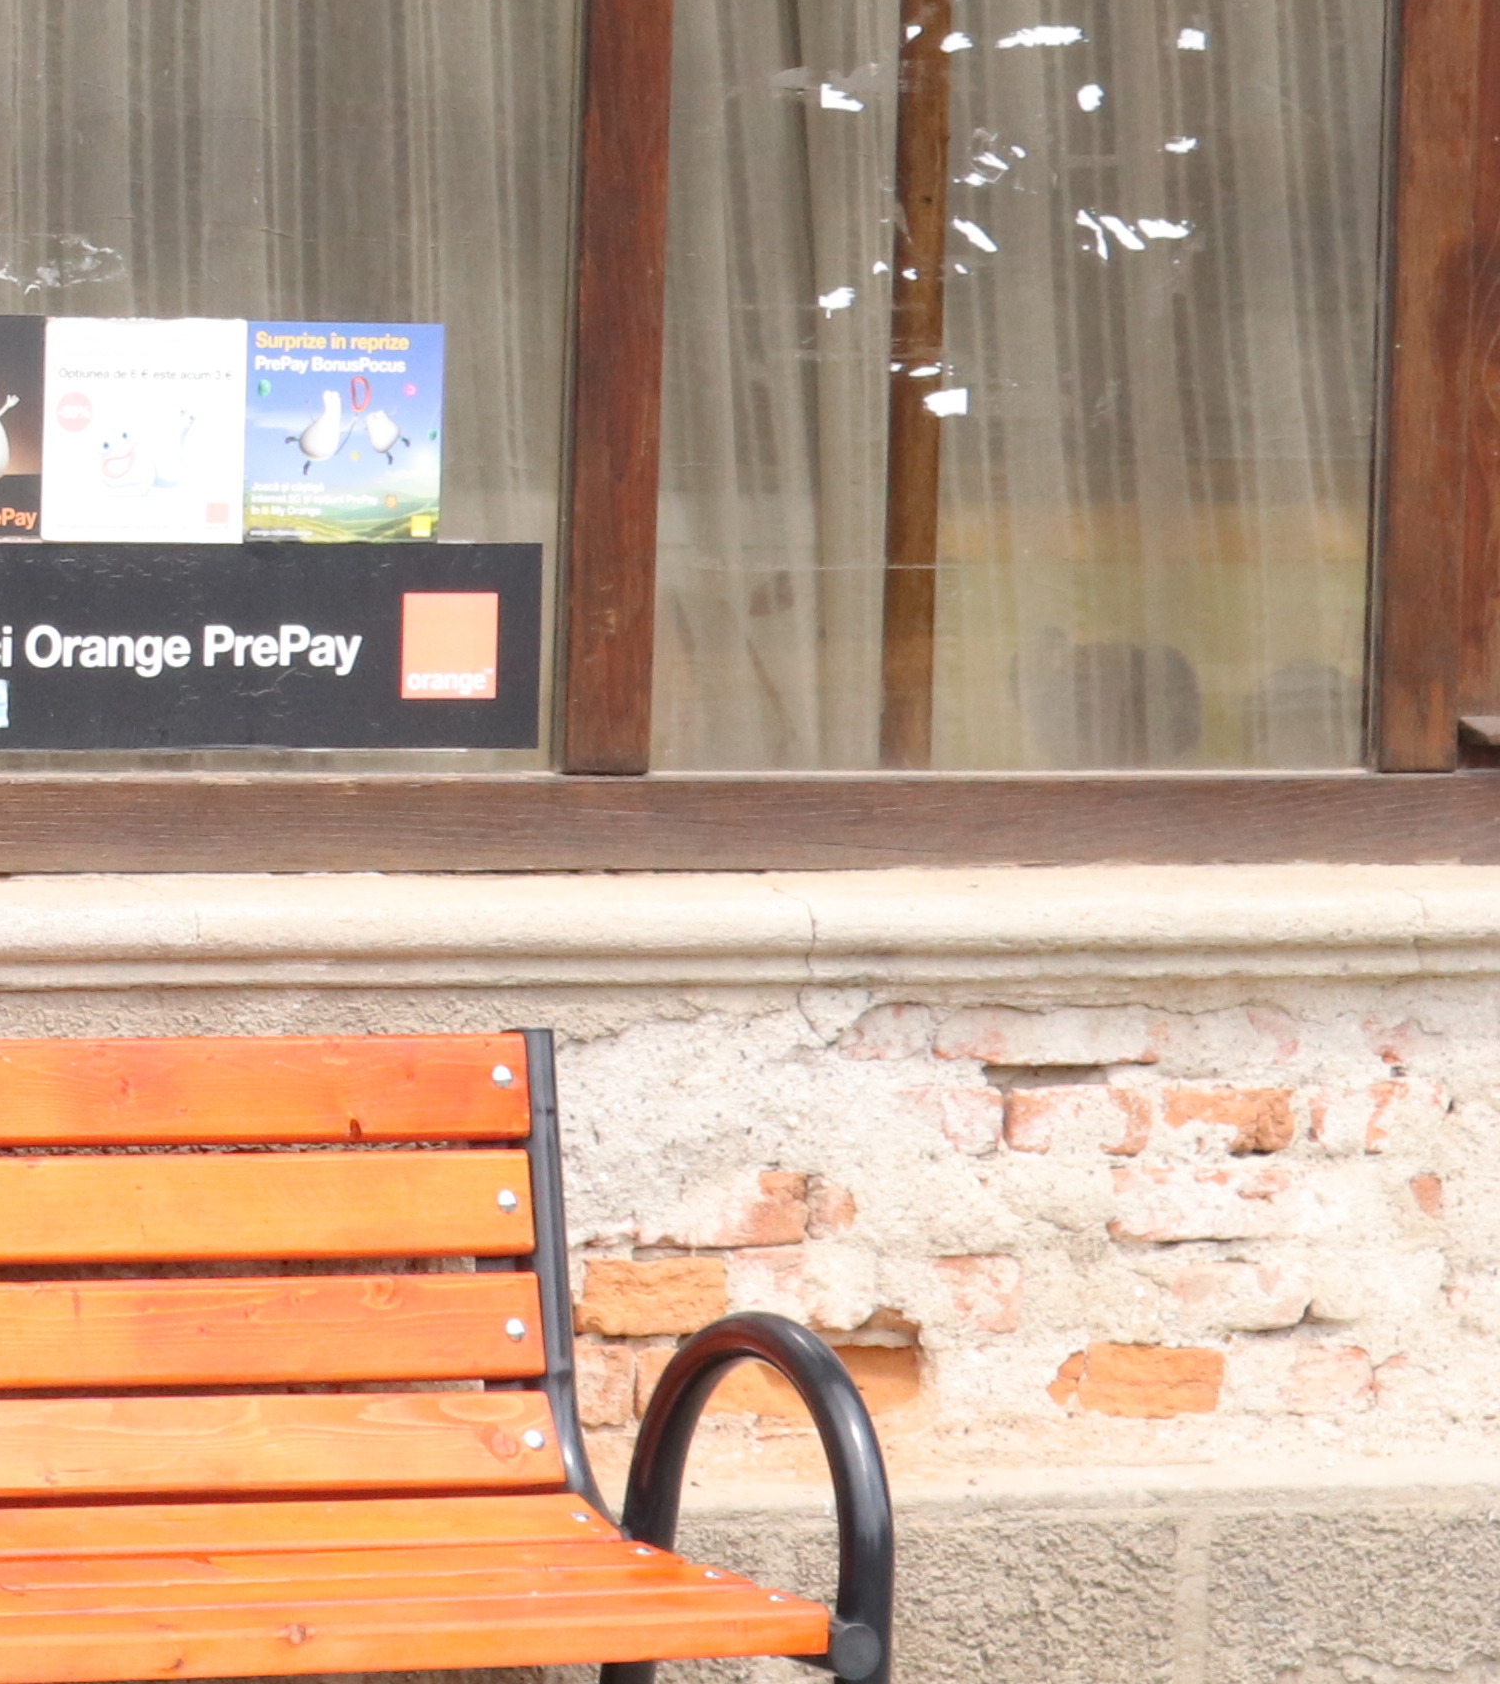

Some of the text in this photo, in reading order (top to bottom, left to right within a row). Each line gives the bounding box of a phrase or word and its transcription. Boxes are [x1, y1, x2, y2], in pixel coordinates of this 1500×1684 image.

[255, 331, 328, 352] Surprize
[350, 333, 411, 353] reprize
[113, 369, 127, 380] de
[130, 369, 137, 380] 6
[153, 370, 176, 380] este
[180, 371, 211, 380] acum
[254, 355, 407, 374] PrePay BonusPocus
[25, 624, 192, 678] Orange
[203, 624, 362, 676] PrePay
